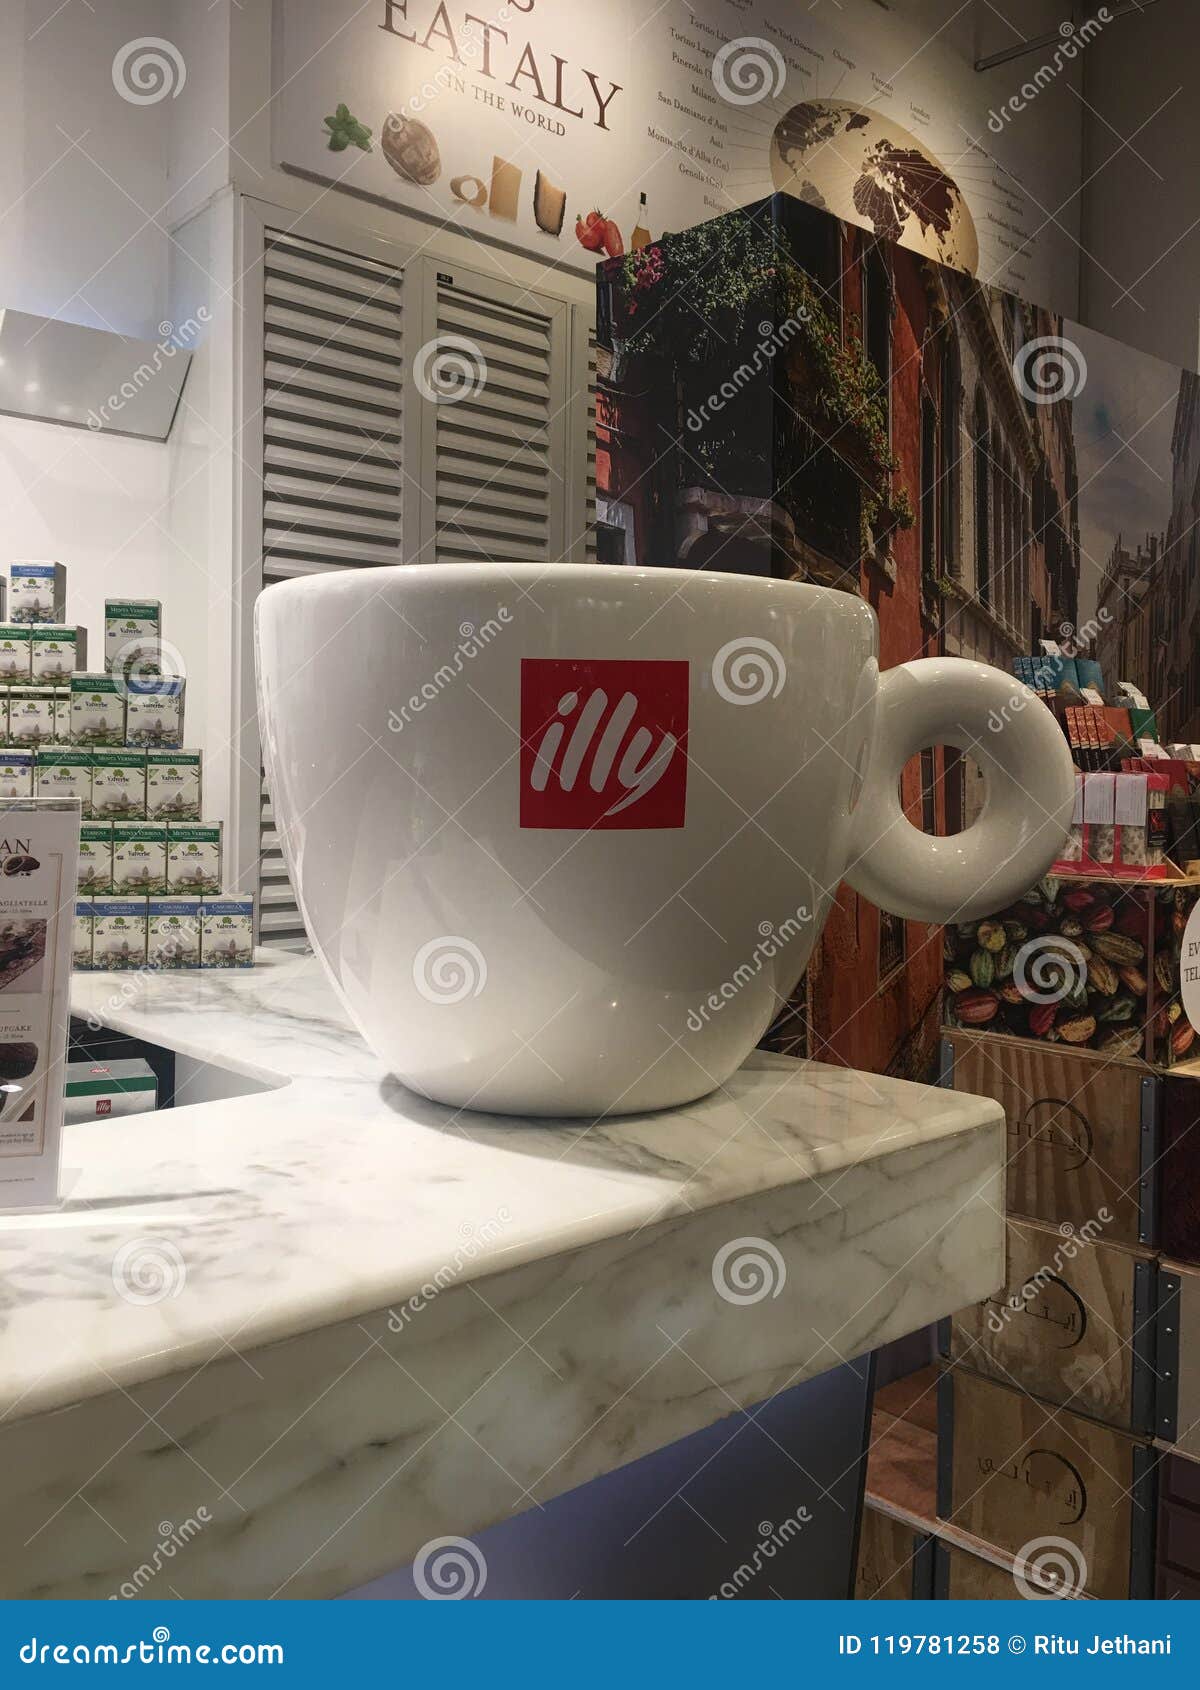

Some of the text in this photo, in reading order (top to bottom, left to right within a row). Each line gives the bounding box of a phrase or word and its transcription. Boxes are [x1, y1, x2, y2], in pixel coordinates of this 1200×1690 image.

[670, 27, 696, 48] Torino
[378, 0, 623, 131] EATALY
[672, 51, 704, 75] Pinerolo
[447, 73, 566, 137] IN THE WORLD
[657, 91, 672, 105] San
[674, 99, 706, 122] Damiano
[691, 84, 717, 104] Milano
[679, 163, 705, 182] Genola
[530, 687, 677, 816] illy
